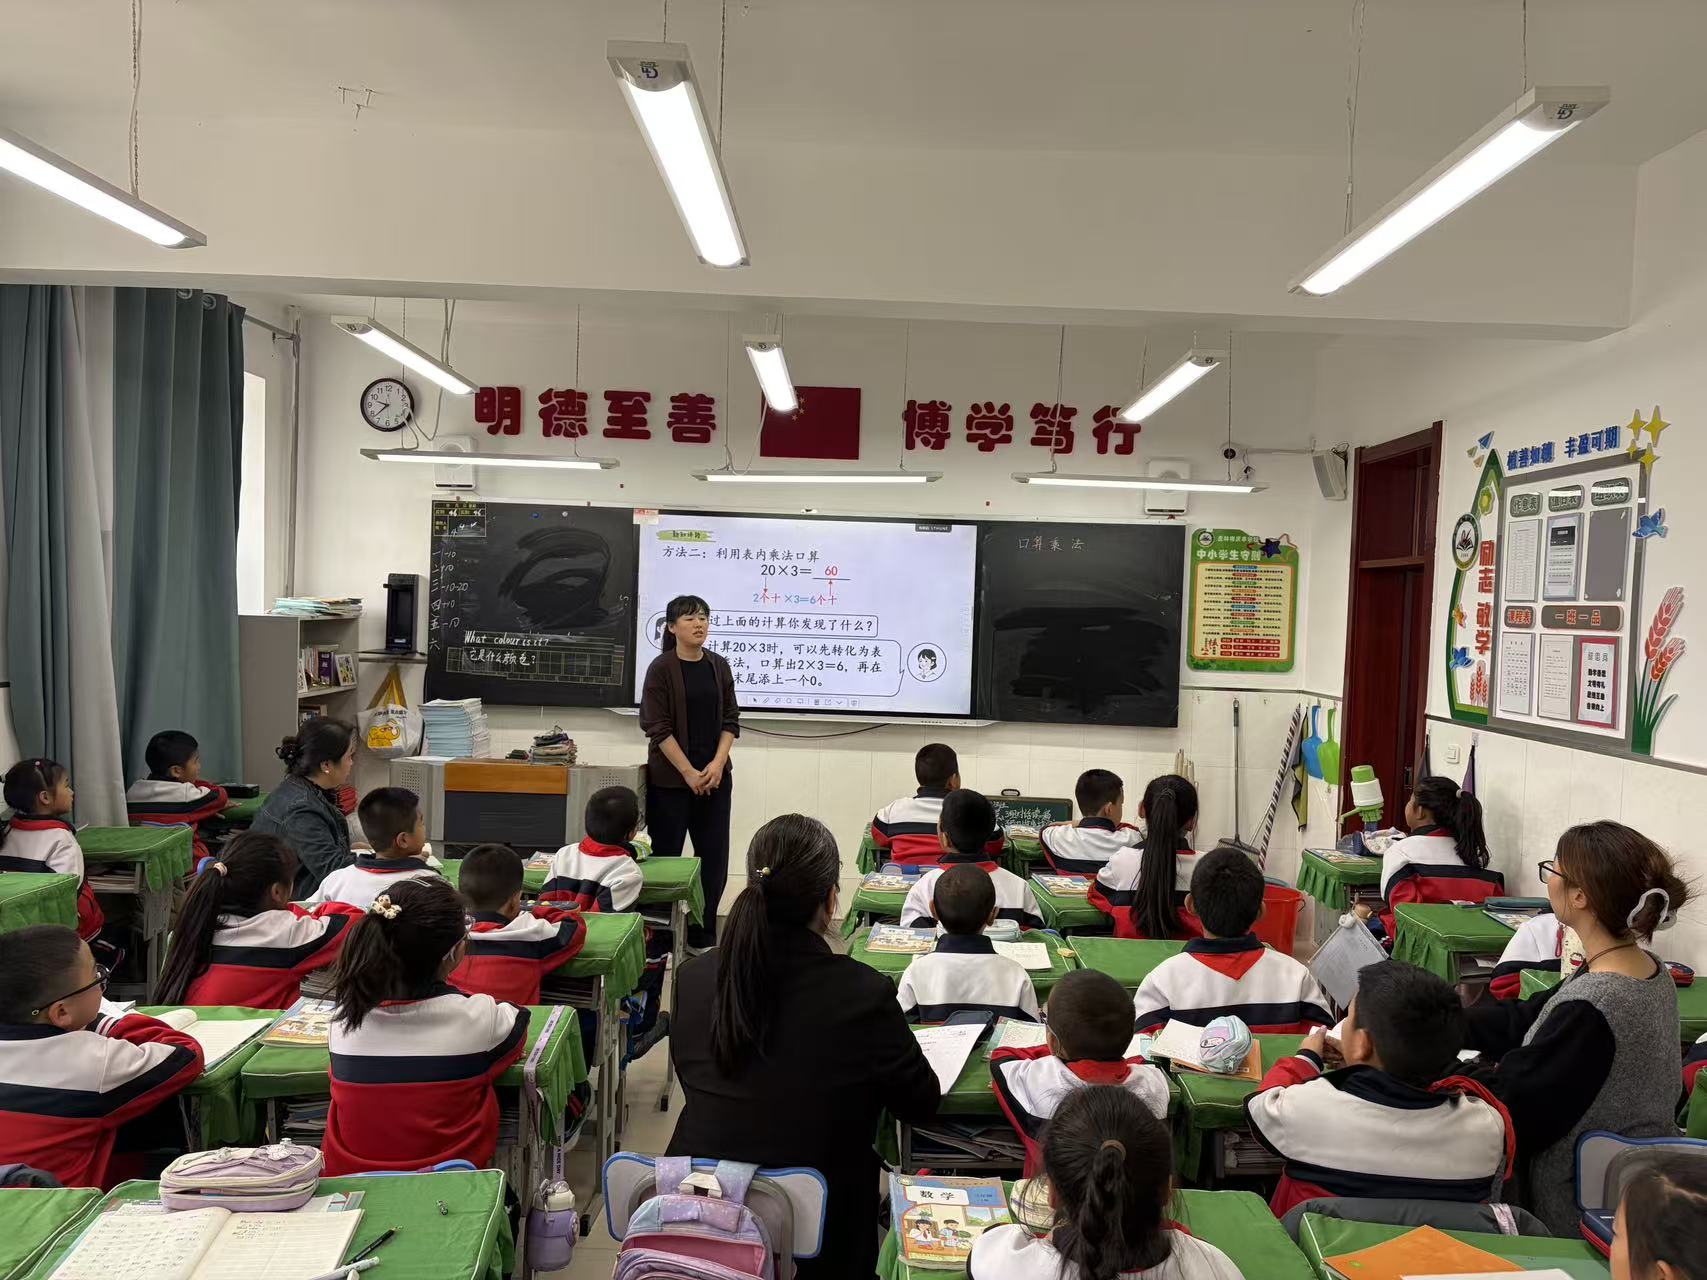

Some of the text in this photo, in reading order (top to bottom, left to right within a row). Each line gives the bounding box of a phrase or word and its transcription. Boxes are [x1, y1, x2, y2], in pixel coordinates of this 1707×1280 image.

[475, 386, 716, 443] 明德至善
[903, 400, 1141, 455] 博学笃行
[1018, 536, 1085, 551] 口算乘法
[1196, 549, 1261, 560] 中小学生守则
[824, 566, 838, 576] 60
[465, 631, 549, 646] What colour is it?
[920, 1190, 954, 1200] 数学
